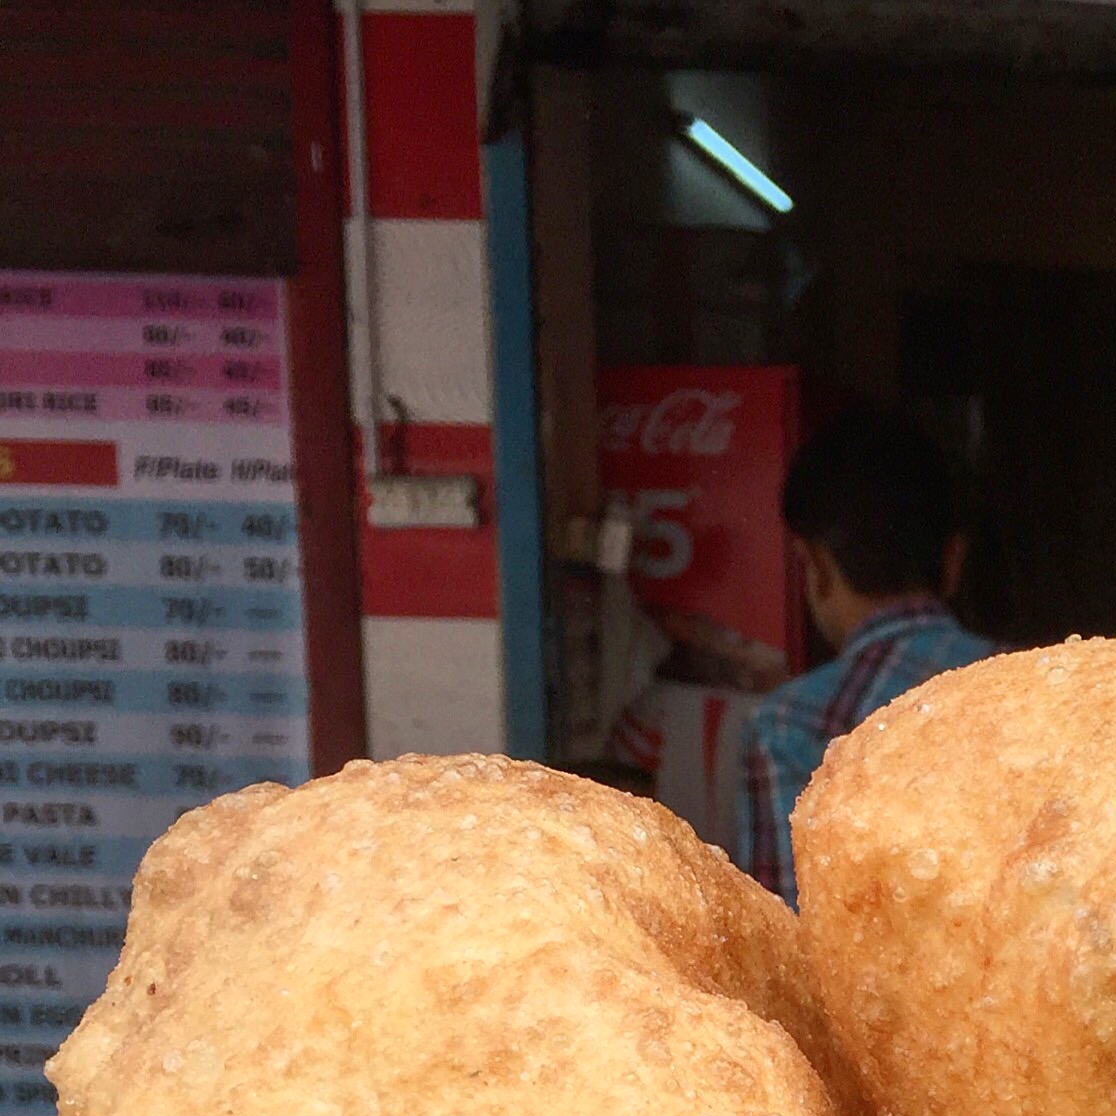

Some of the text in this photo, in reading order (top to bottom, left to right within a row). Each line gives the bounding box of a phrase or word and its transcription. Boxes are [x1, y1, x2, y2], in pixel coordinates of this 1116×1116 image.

[133, 454, 222, 482] F/Plate
[0, 508, 108, 536] OTATO
[0, 552, 108, 579] OTATO
[3, 801, 98, 827] PASTA
